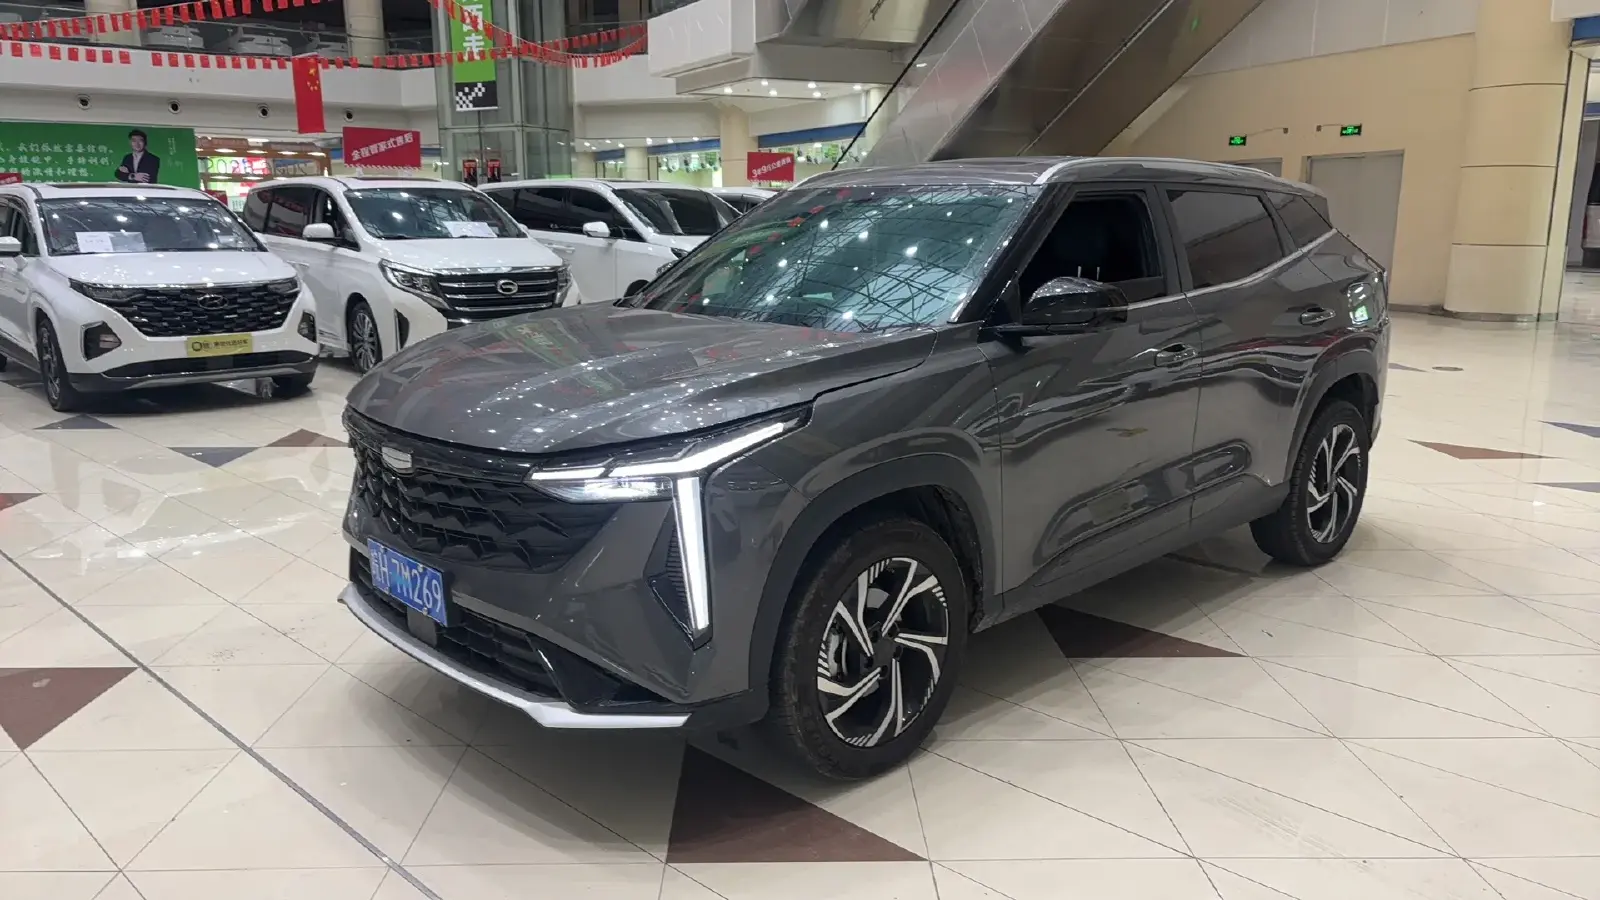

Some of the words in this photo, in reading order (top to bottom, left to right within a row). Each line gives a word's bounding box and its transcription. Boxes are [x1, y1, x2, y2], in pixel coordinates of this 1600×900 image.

[351, 132, 414, 161] 全程管家式售后
